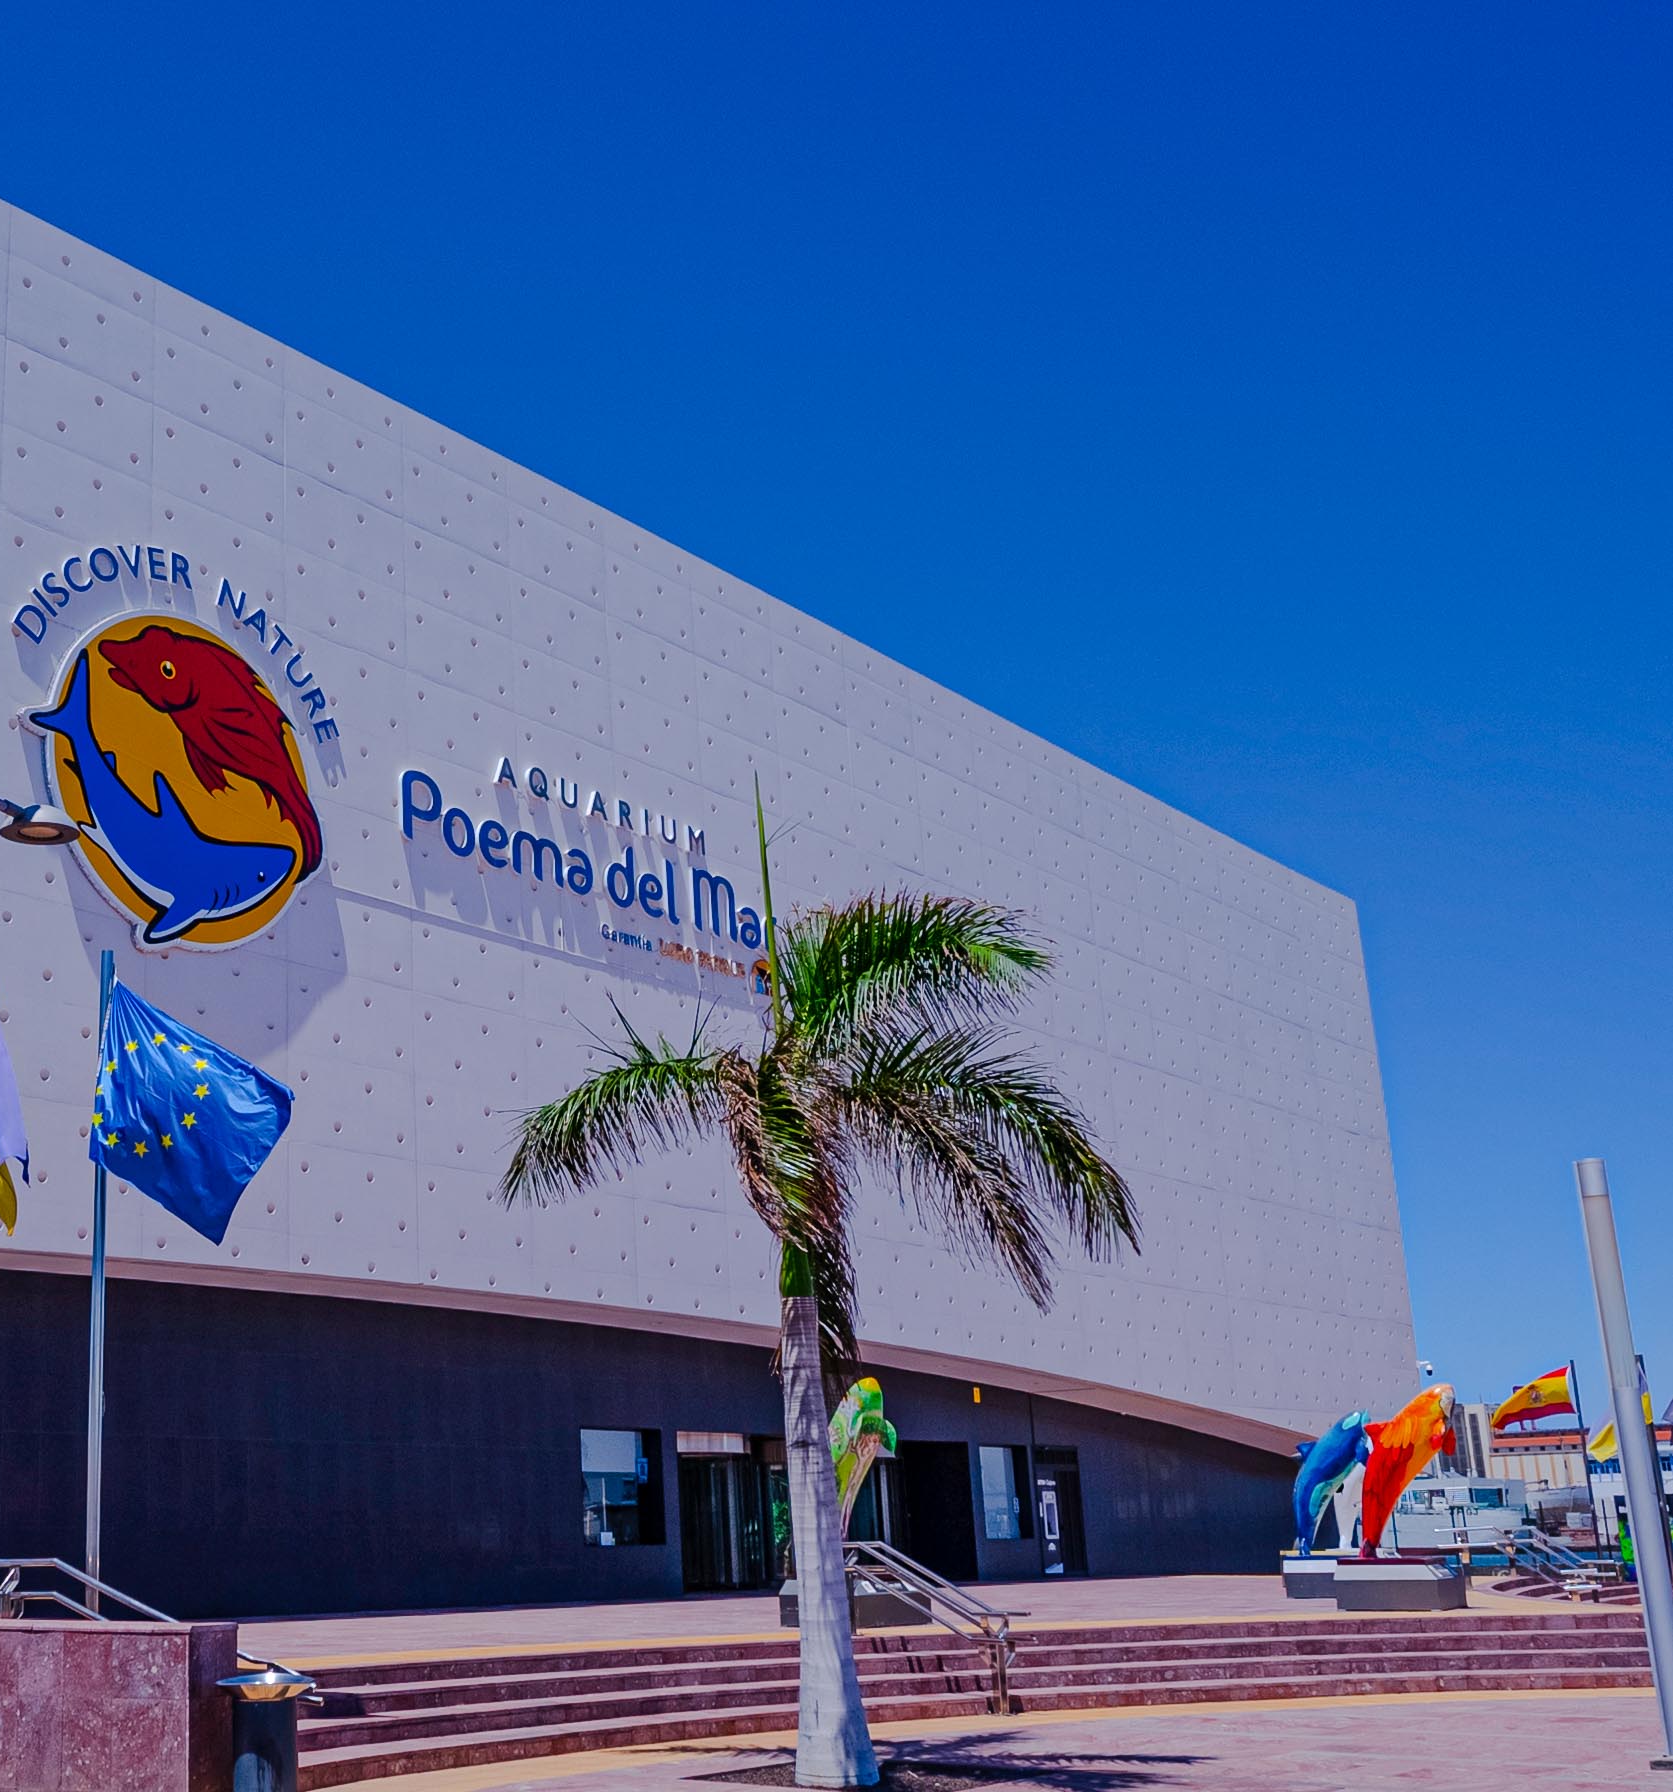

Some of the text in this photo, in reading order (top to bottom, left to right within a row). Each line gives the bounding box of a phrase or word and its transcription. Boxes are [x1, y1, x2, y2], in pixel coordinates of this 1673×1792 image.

[13, 544, 341, 744] DISCOVER NATURE
[399, 769, 594, 895] Poema
[607, 846, 681, 926] del
[494, 757, 707, 856] AQUARIUM
